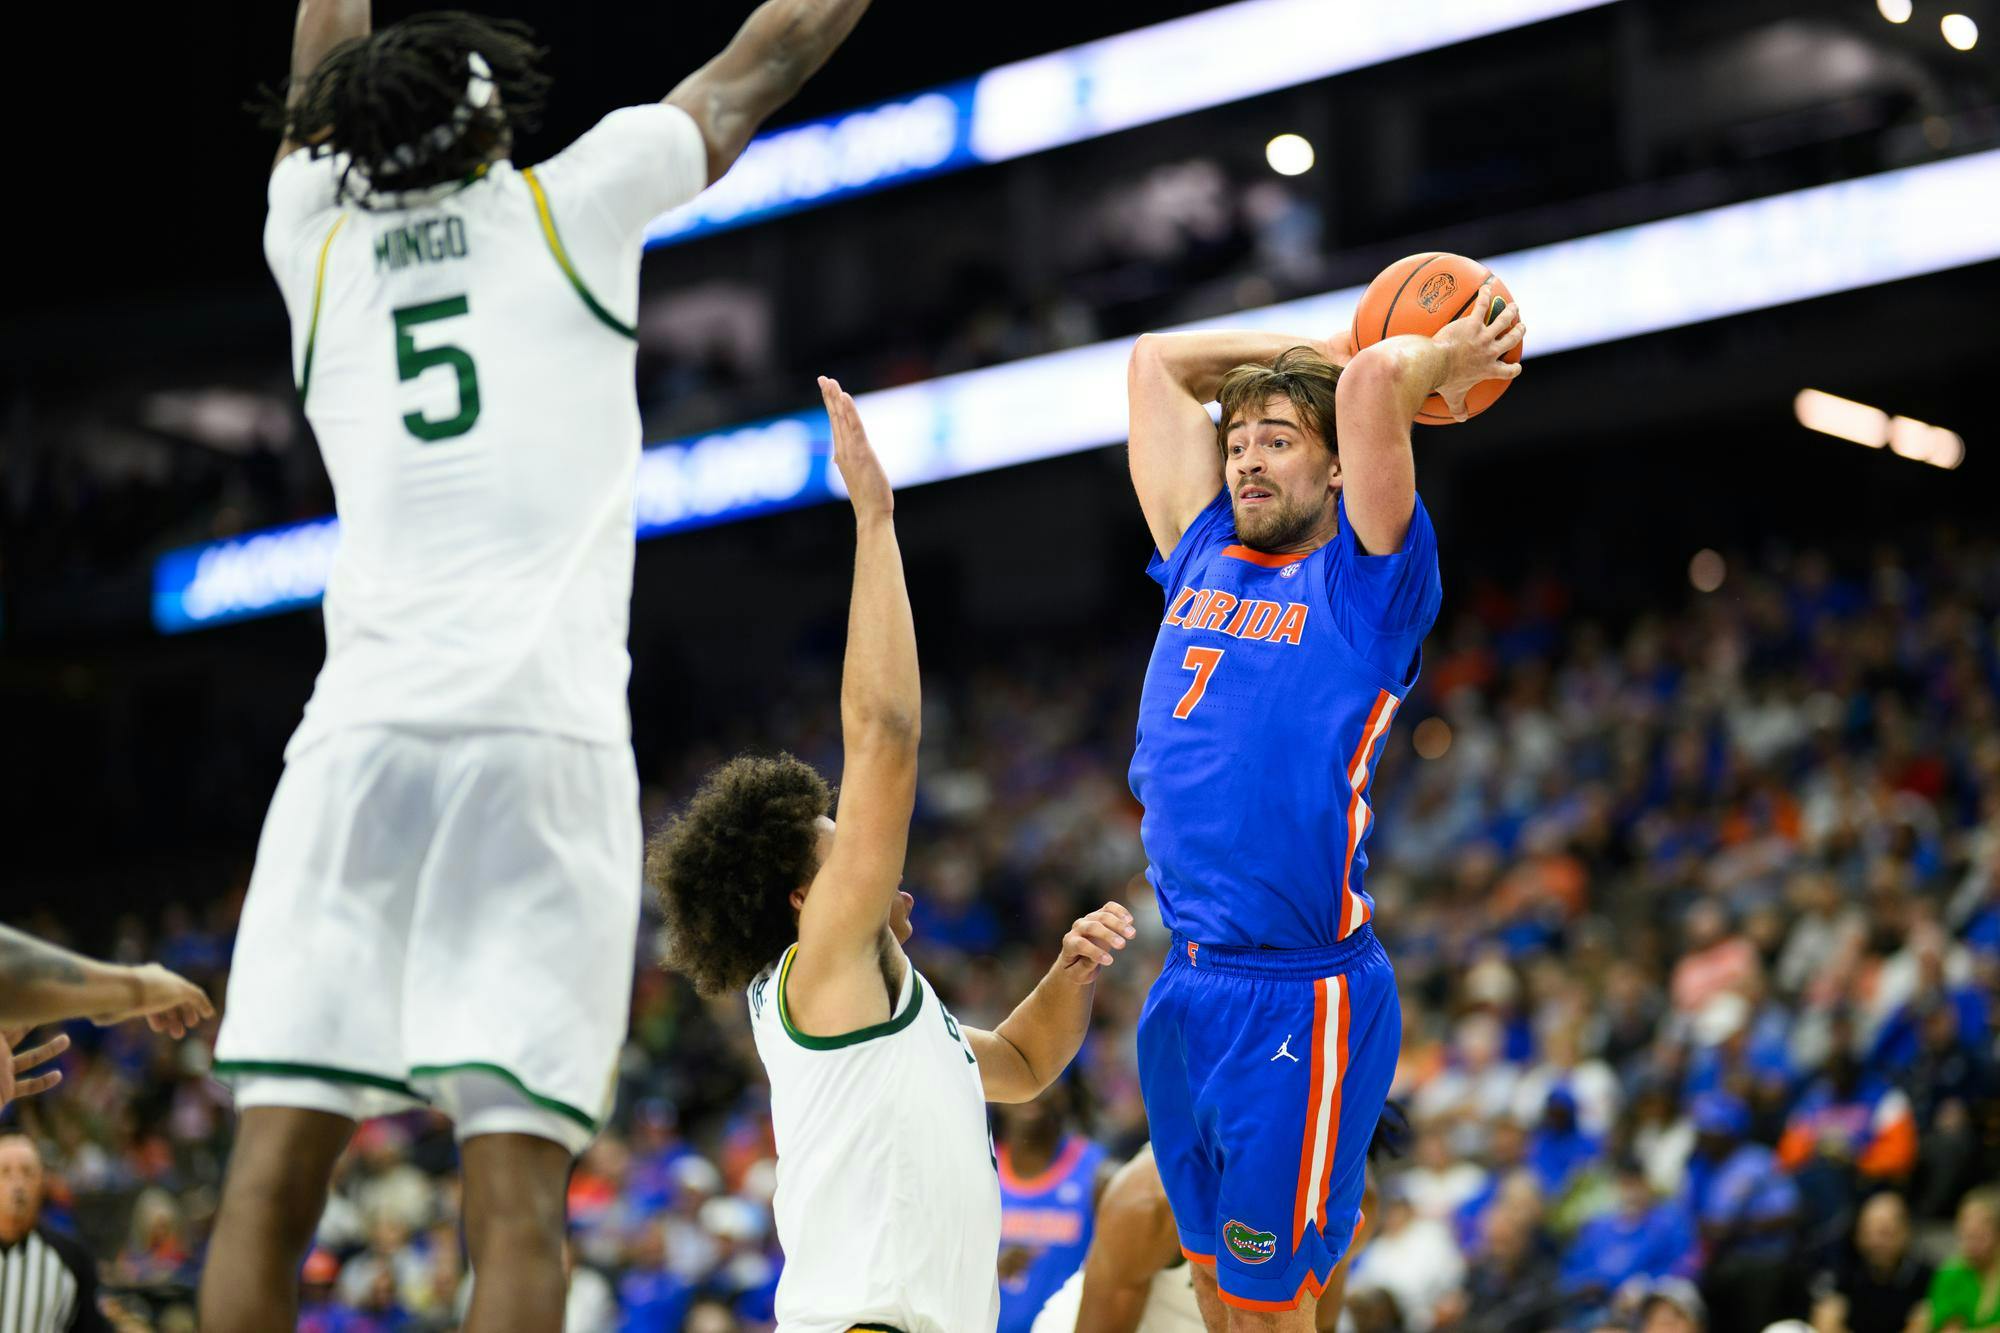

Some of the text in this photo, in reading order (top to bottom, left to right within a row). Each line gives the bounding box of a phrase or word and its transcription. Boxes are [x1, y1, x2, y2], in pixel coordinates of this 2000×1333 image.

[374, 216, 468, 272] MINGO
[392, 295, 480, 442] 5
[1161, 586, 1309, 646] LORIDA
[1172, 645, 1225, 720] 7
